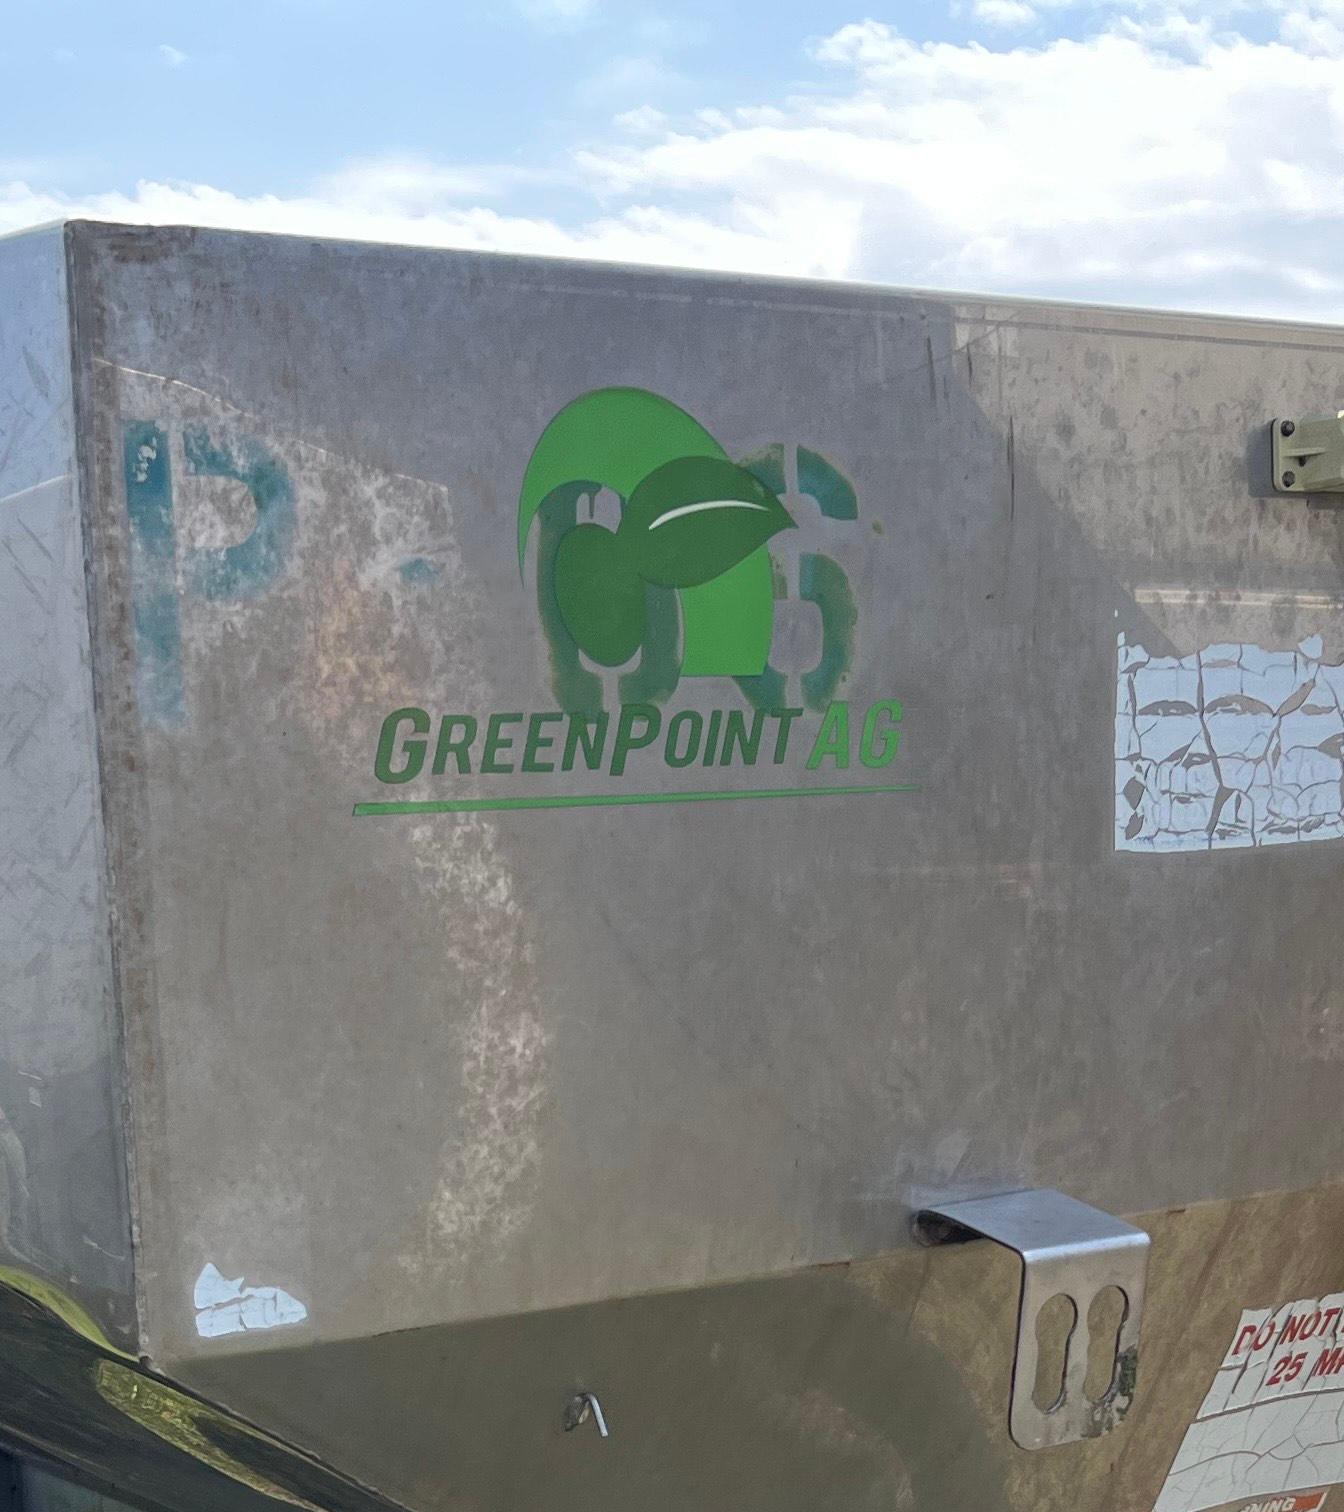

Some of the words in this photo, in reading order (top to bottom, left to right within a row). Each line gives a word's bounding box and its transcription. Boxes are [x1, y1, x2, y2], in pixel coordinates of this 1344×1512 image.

[373, 702, 805, 784] GREENPOINT
[806, 699, 904, 771] AG
[1231, 1320, 1276, 1356] DO
[1279, 1306, 1342, 1346] NOT
[1265, 1350, 1308, 1386] 25
